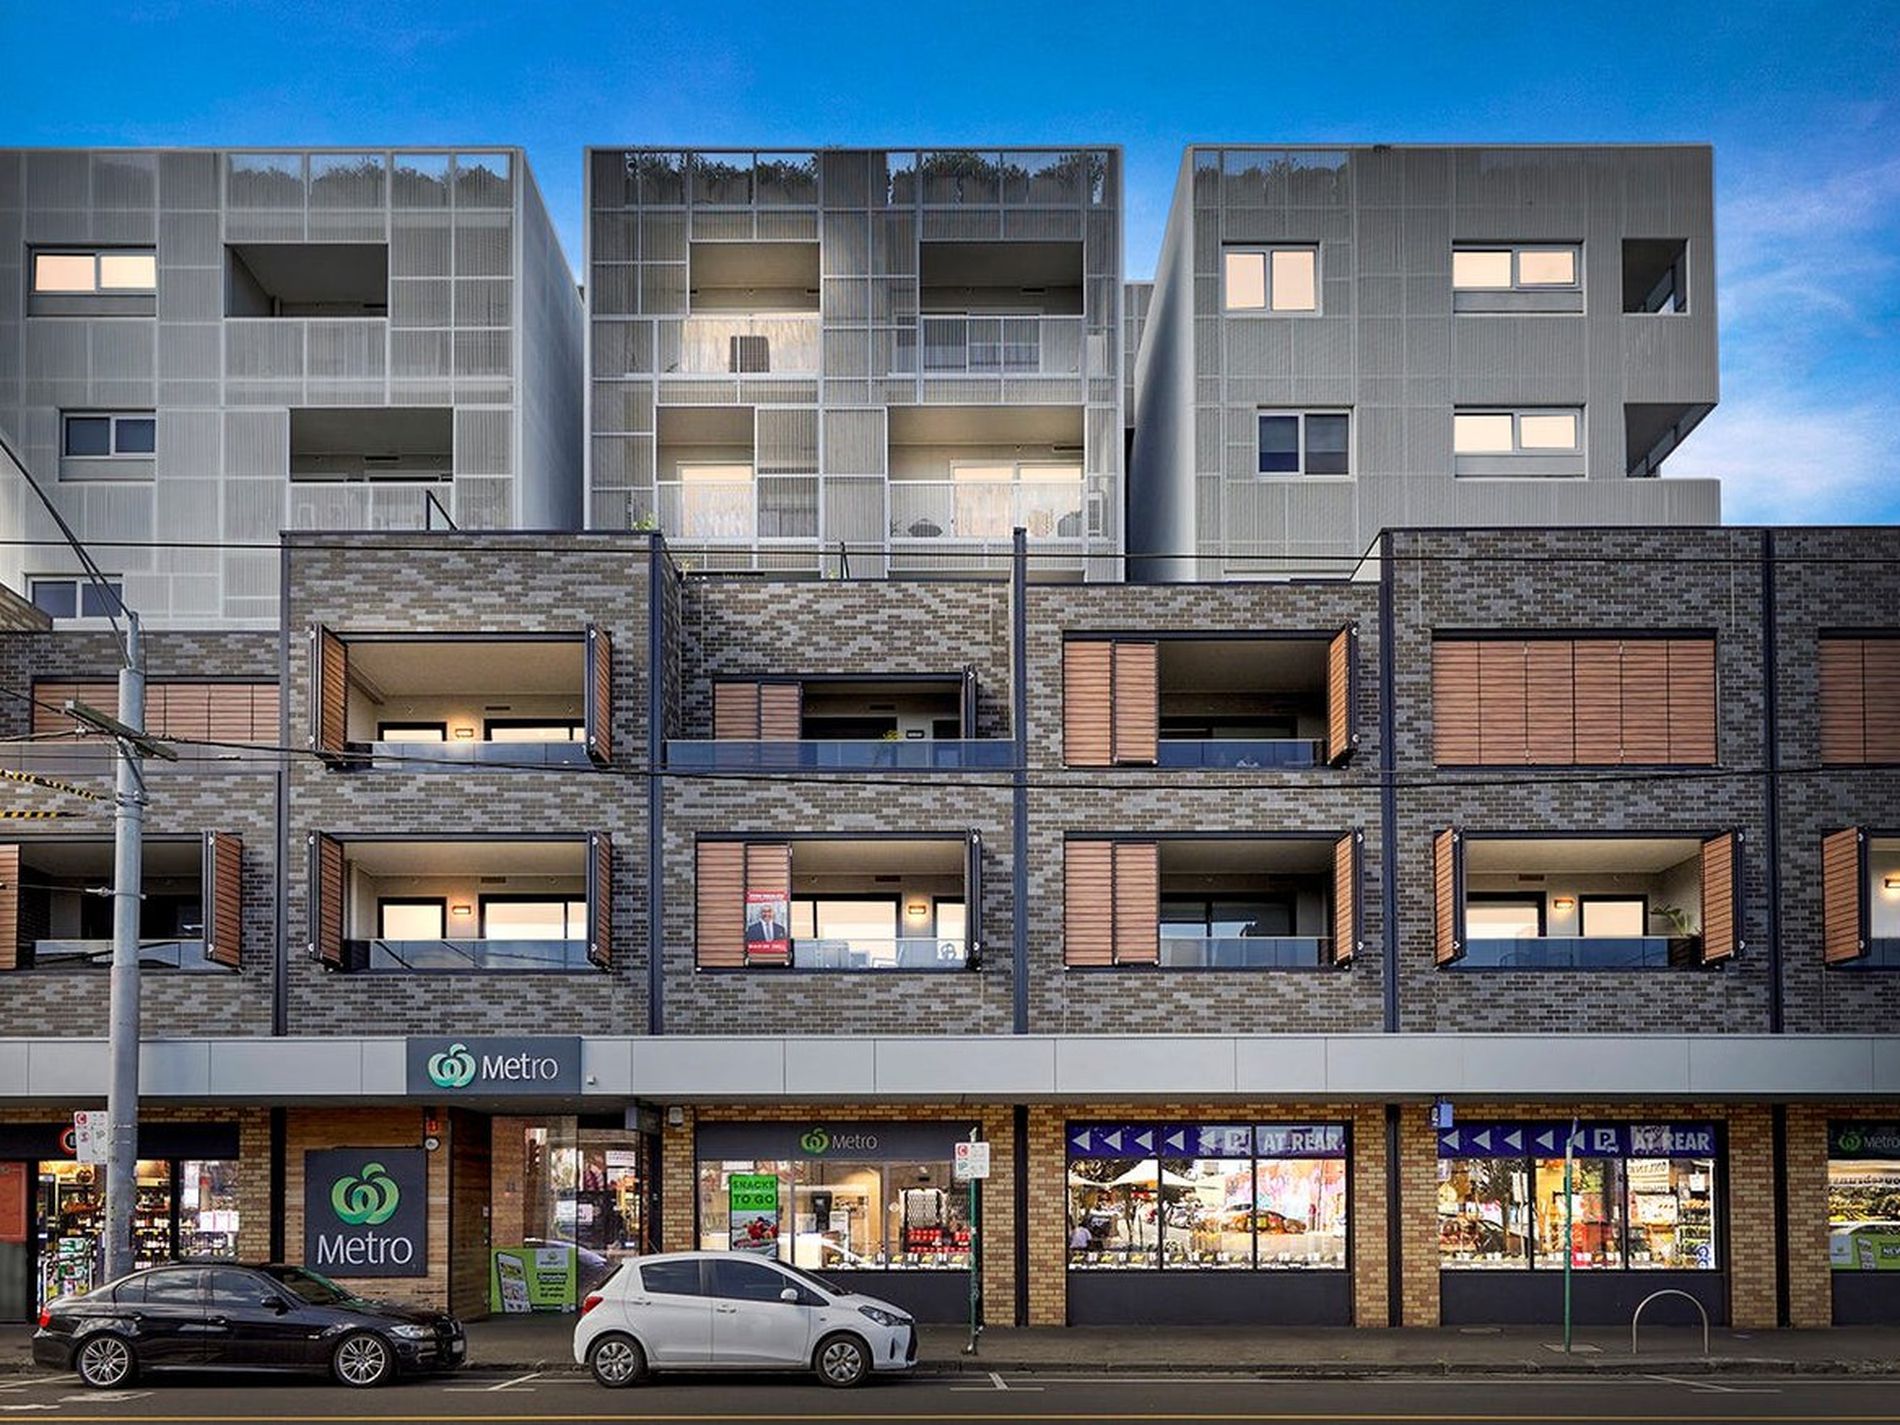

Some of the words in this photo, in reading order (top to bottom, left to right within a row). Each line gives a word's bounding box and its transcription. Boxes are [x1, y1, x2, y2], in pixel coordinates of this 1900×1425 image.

[482, 1053, 558, 1080] Metro
[832, 1134, 878, 1149] Metro
[1263, 1133, 1287, 1151] AT
[1291, 1133, 1340, 1151] REAR
[1664, 1132, 1711, 1151] REAR
[1863, 1135, 1900, 1149] Metro
[733, 1180, 775, 1189] SNACKS
[733, 1194, 751, 1204] TO
[755, 1194, 775, 1204] GO
[317, 1231, 413, 1264] Metro
